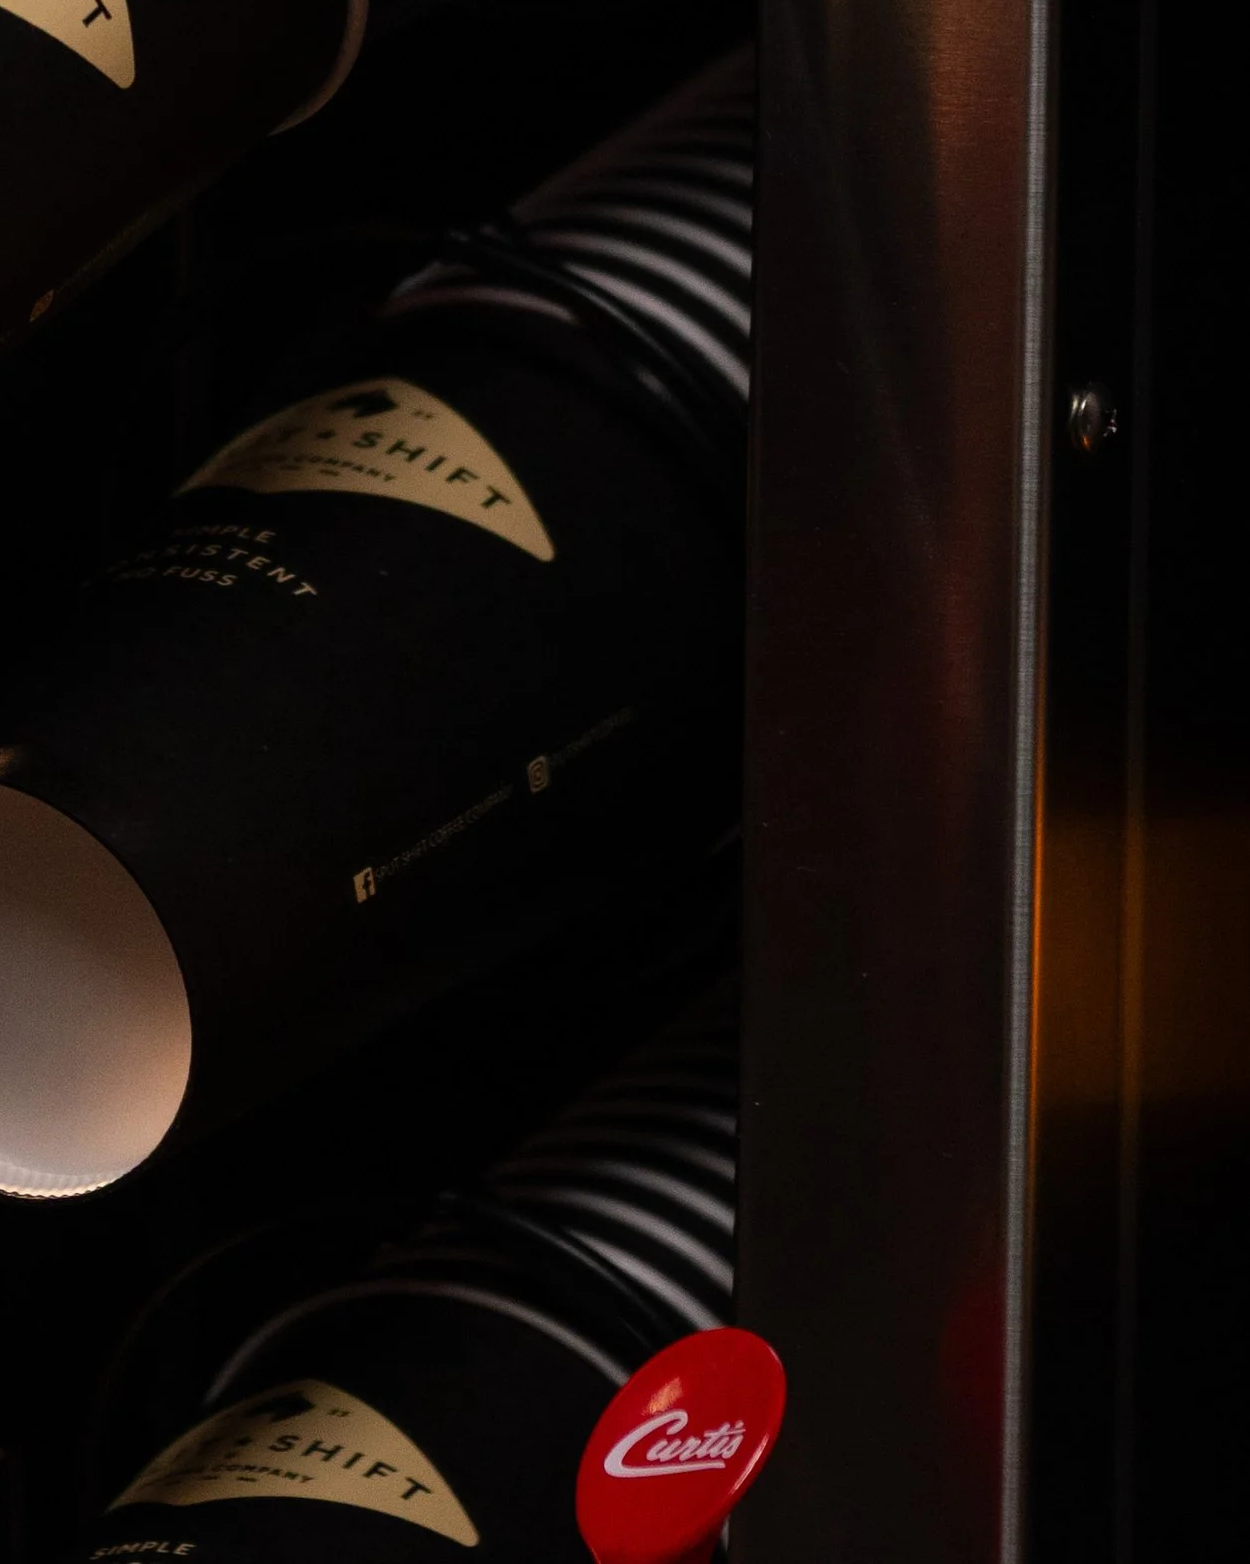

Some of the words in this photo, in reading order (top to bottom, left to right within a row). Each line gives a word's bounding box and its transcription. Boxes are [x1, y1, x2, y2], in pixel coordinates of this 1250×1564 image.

[353, 432, 511, 510] SHIFT
[161, 565, 239, 587] FUSS
[268, 1434, 432, 1502] SHIFT
[603, 1407, 747, 1479] Curtis
[90, 1539, 197, 1561] SIMPLE
